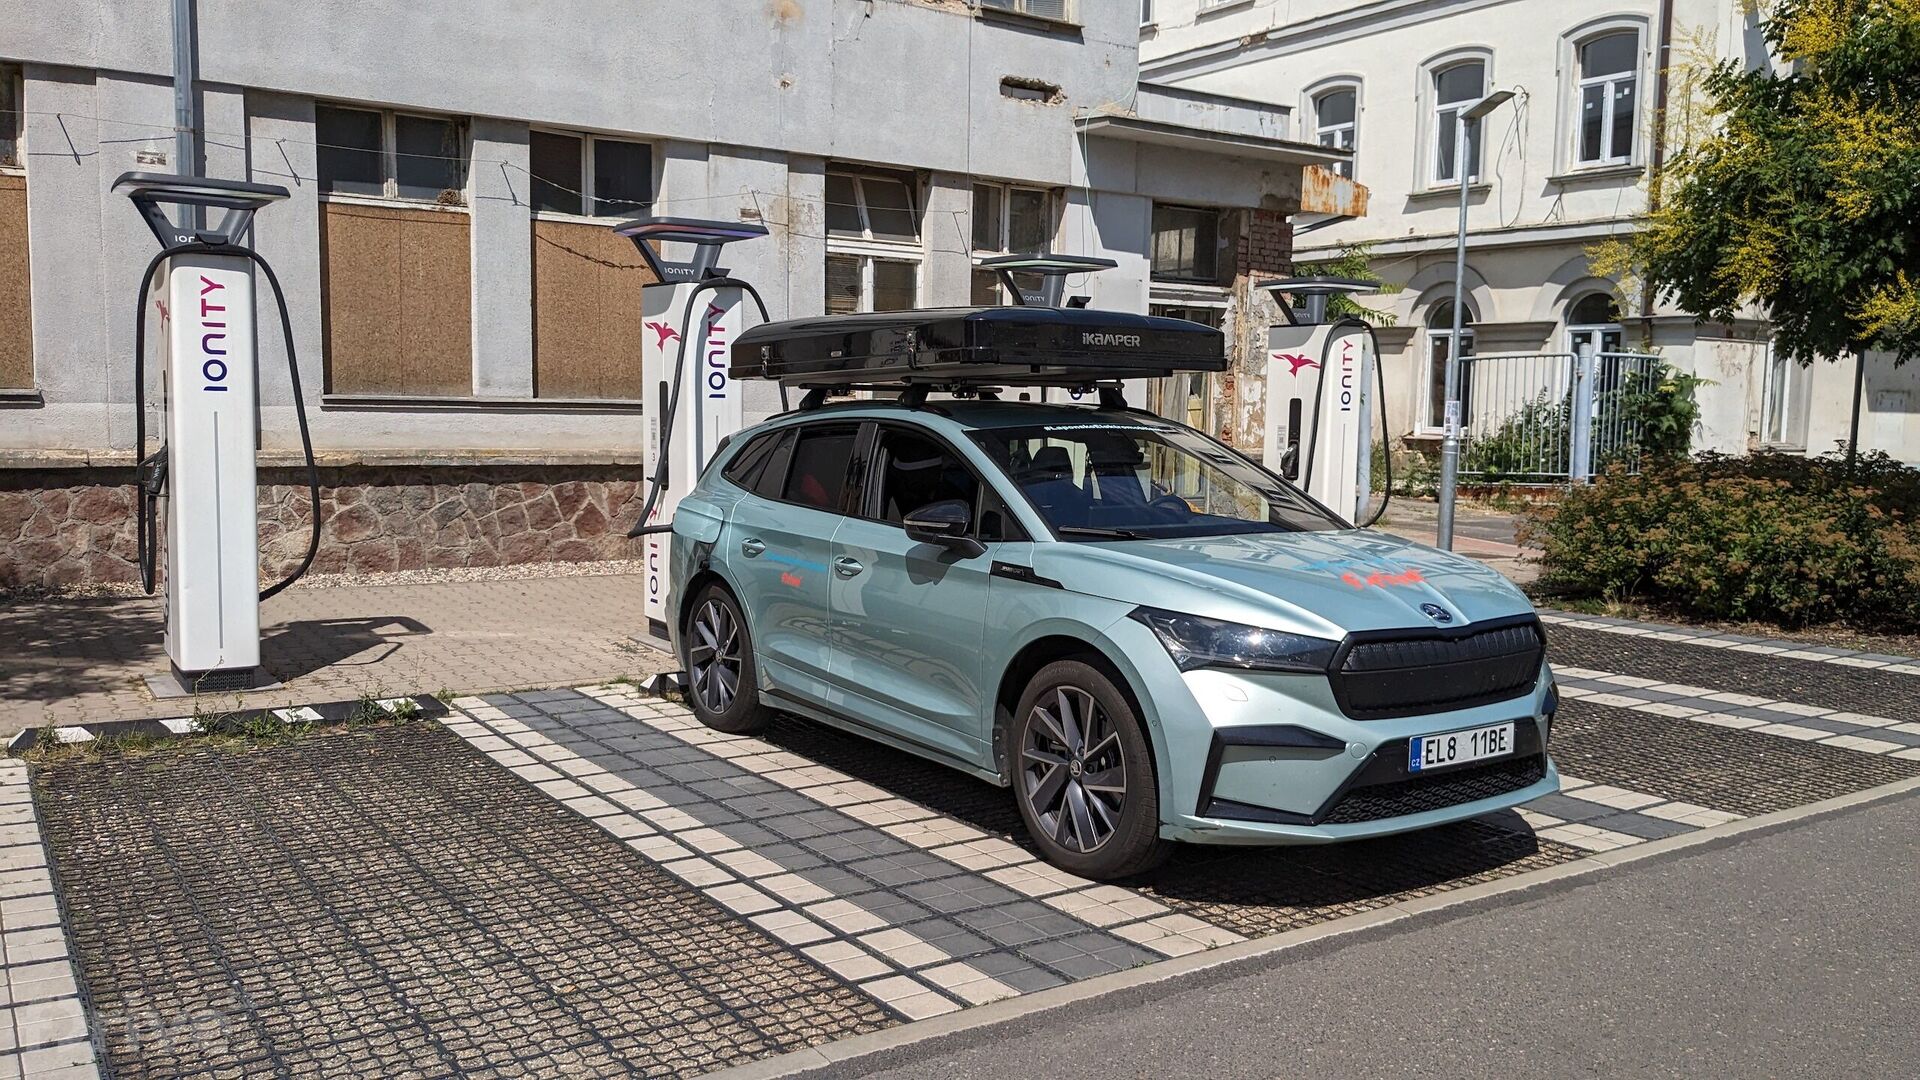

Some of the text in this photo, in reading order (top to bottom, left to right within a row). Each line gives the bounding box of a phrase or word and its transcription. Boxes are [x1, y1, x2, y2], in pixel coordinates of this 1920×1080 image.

[663, 266, 695, 276] IONITY
[1022, 294, 1045, 303] IONITY
[200, 274, 228, 392] IONITY
[708, 302, 726, 399] IONITY
[1340, 339, 1354, 412] IONITY
[1411, 758, 1420, 767] CZ
[1425, 727, 1507, 765] EL8 11BE
